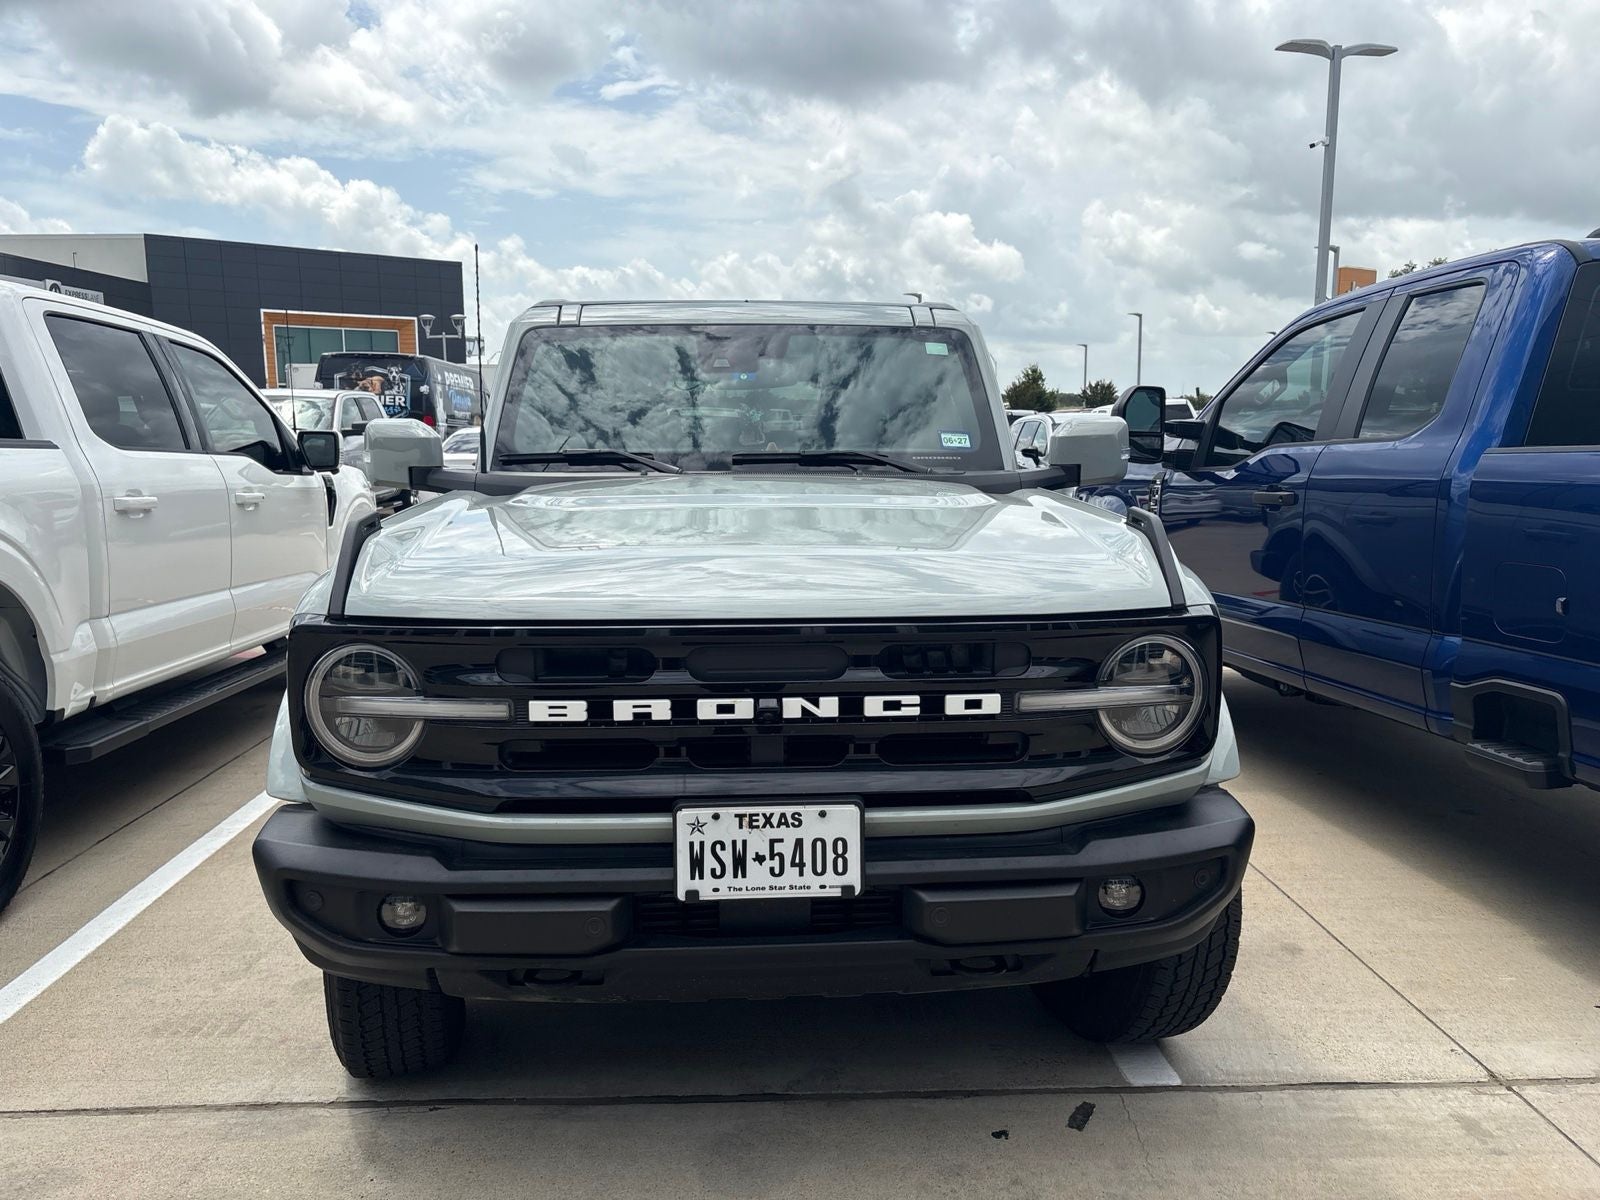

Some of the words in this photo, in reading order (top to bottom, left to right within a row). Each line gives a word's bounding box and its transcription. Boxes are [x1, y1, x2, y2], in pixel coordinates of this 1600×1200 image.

[528, 693, 1002, 722] BRONCO
[734, 811, 803, 830] TEXAS
[689, 839, 748, 881] WSW
[768, 836, 849, 878] 5408
